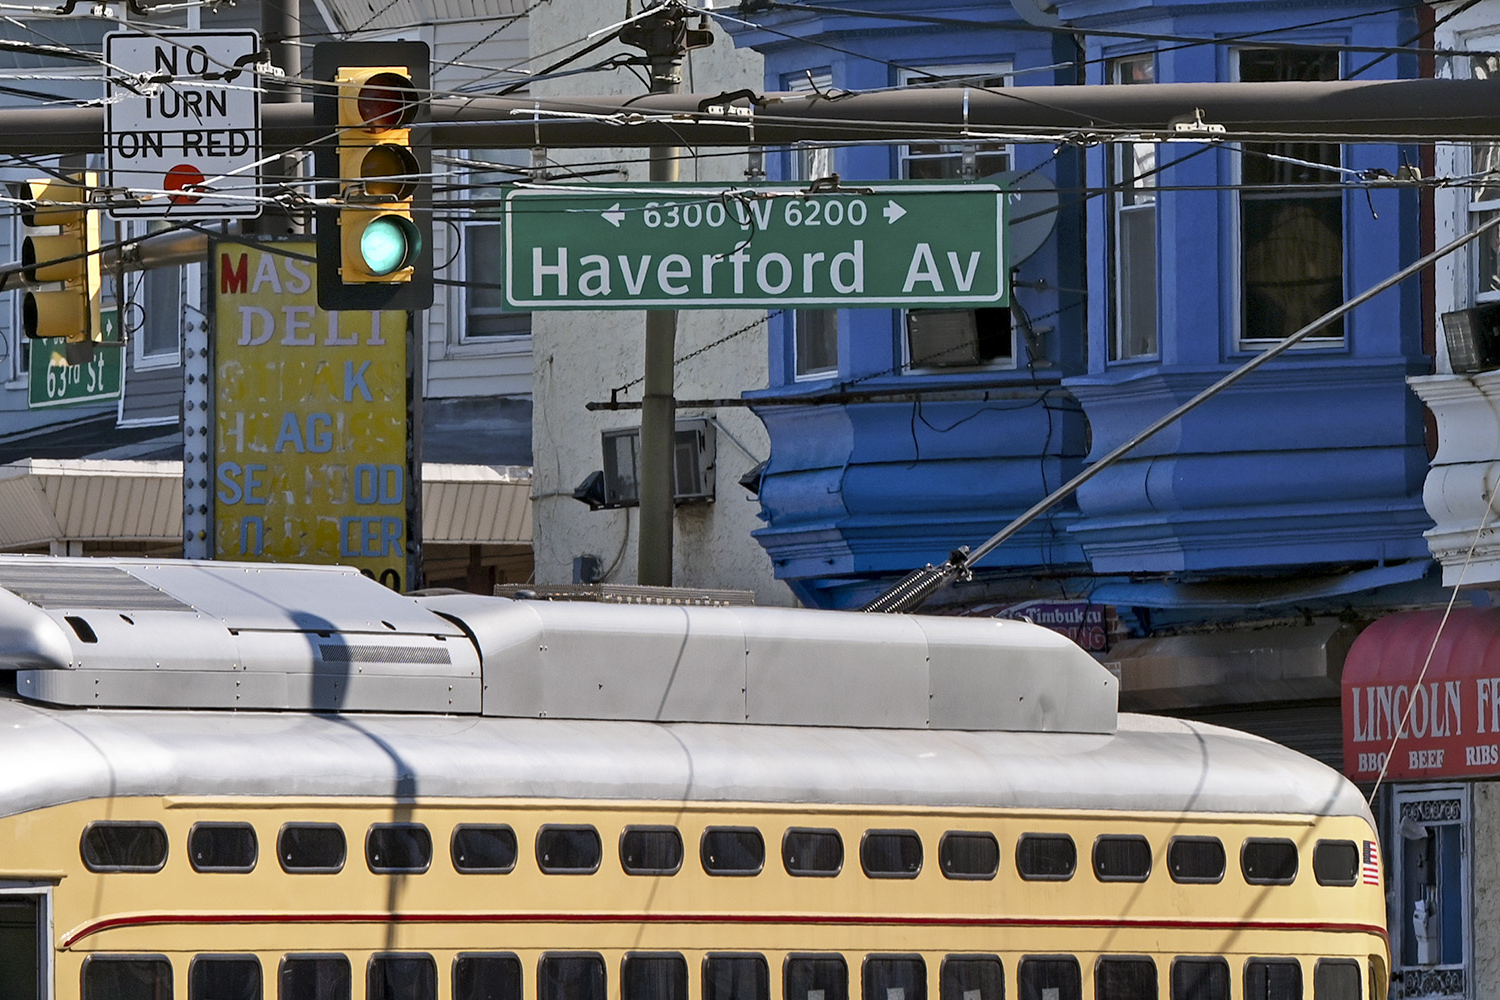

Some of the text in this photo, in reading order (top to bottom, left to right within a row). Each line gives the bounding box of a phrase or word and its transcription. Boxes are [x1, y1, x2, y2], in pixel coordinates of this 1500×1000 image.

[155, 45, 209, 76] NO
[141, 89, 227, 119] TURN
[118, 131, 249, 158] ON RED
[643, 199, 867, 230] 6300 W 6200
[532, 240, 981, 297] Haverford Av
[237, 306, 387, 346] DELI
[46, 352, 105, 398] 63rd St
[1025, 607, 1101, 624] Timbuktu
[1351, 680, 1462, 742] LINCOLN
[1357, 744, 1499, 778] BBQ BEEF RIBS
